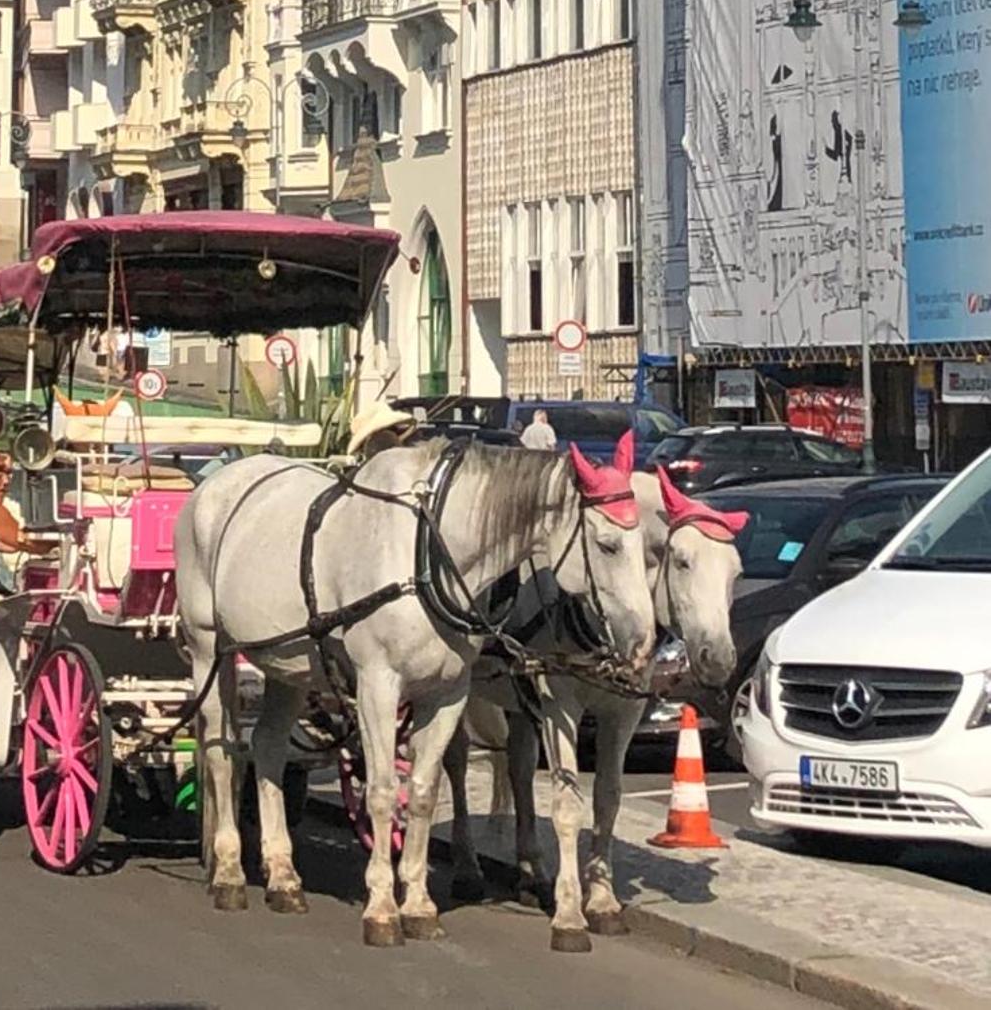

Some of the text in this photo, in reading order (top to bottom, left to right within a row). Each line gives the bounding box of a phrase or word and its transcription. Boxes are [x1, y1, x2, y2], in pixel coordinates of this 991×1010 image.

[907, 77, 921, 98] na
[924, 71, 938, 94] nic
[849, 764, 889, 788] 7586
